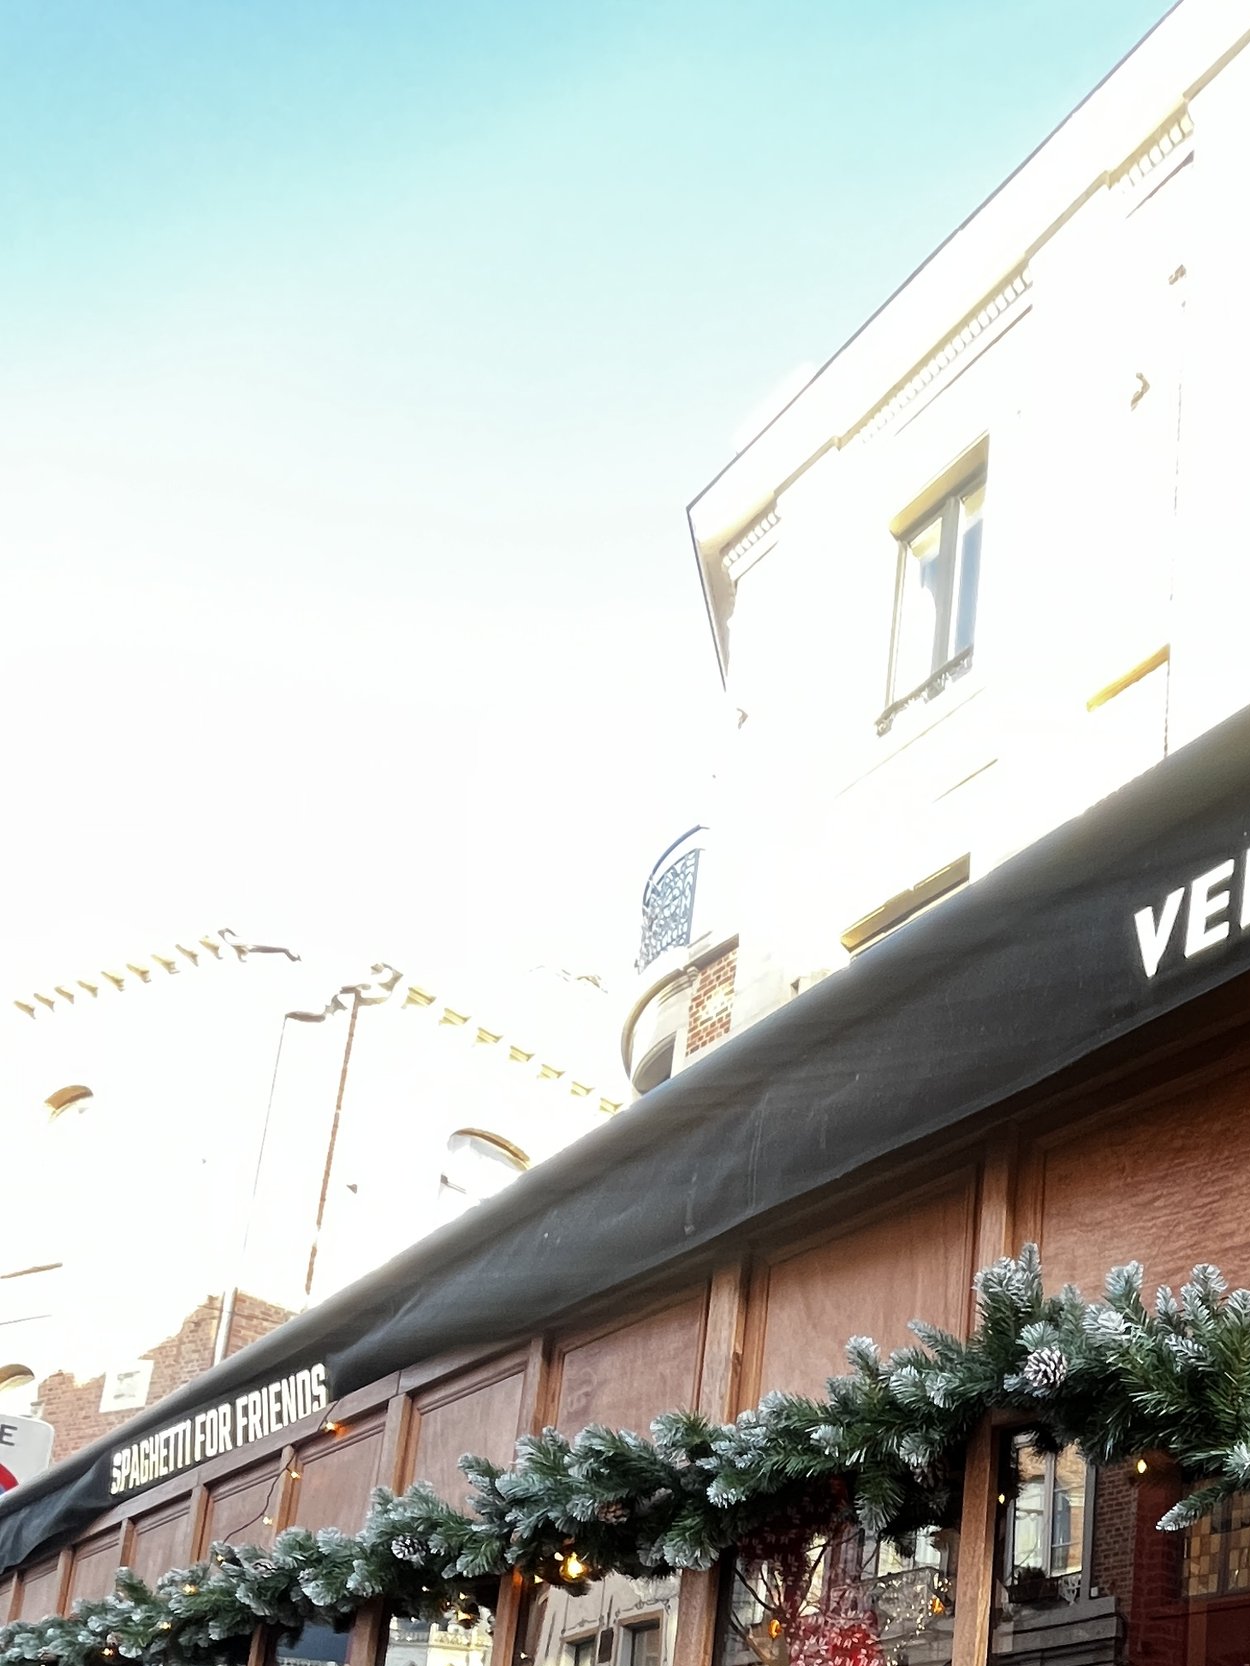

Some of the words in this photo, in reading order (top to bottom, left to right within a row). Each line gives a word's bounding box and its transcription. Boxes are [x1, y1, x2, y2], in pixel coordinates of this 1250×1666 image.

[111, 1418, 191, 1495] SPAGHETTI
[194, 1403, 234, 1460] FOR
[235, 1362, 328, 1448] FRIENDS
